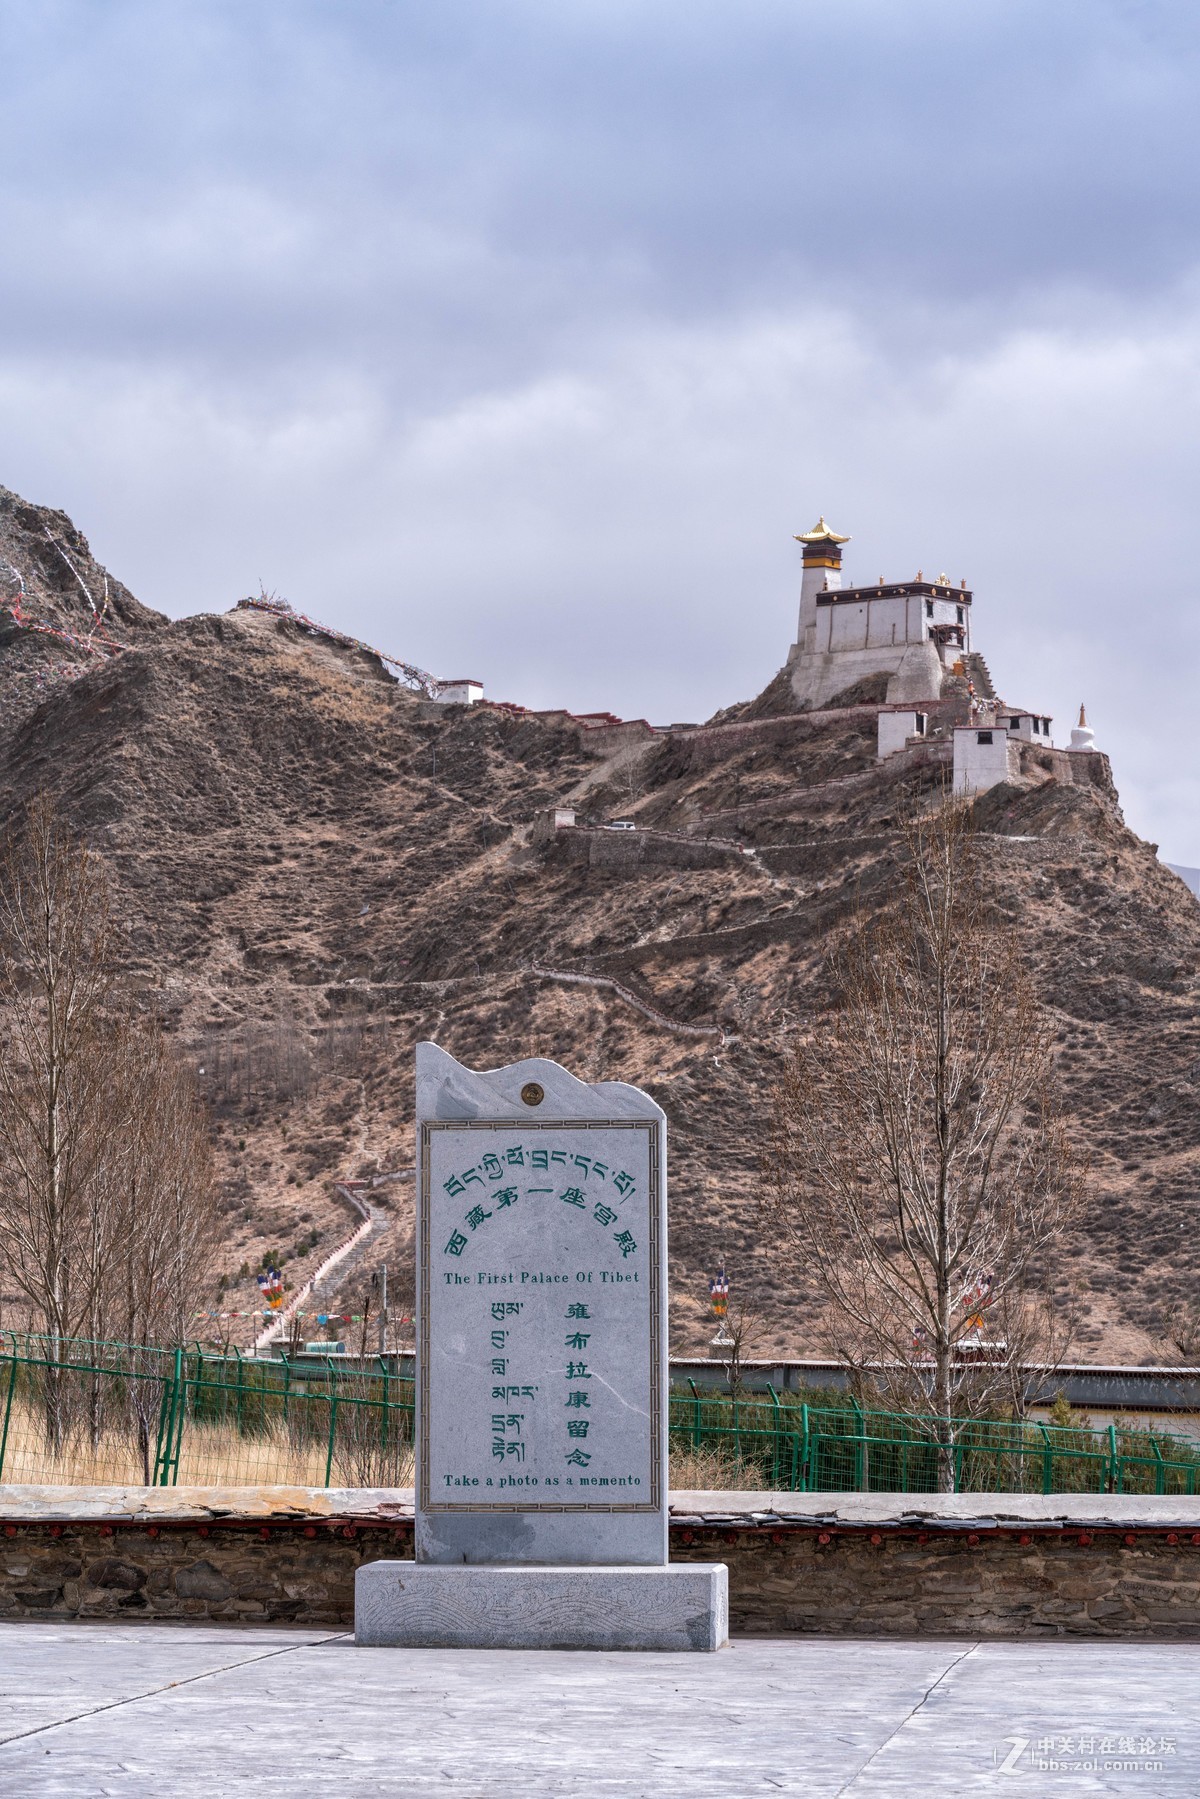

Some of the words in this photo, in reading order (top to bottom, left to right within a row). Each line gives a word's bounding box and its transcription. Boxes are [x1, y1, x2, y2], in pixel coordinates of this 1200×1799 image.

[444, 1186, 638, 1259] 西藏第一座宫殿
[444, 1272, 470, 1285] The
[478, 1272, 514, 1285] First
[521, 1271, 569, 1285] Palace
[576, 1271, 593, 1284] Of
[601, 1271, 639, 1284] Tibet
[564, 1302, 592, 1467] 雍布拉康留念
[444, 1474, 479, 1486] Take
[486, 1477, 493, 1486] a
[499, 1474, 538, 1488] photo
[545, 1477, 559, 1486] as
[566, 1477, 573, 1486] a
[580, 1475, 641, 1486] memento
